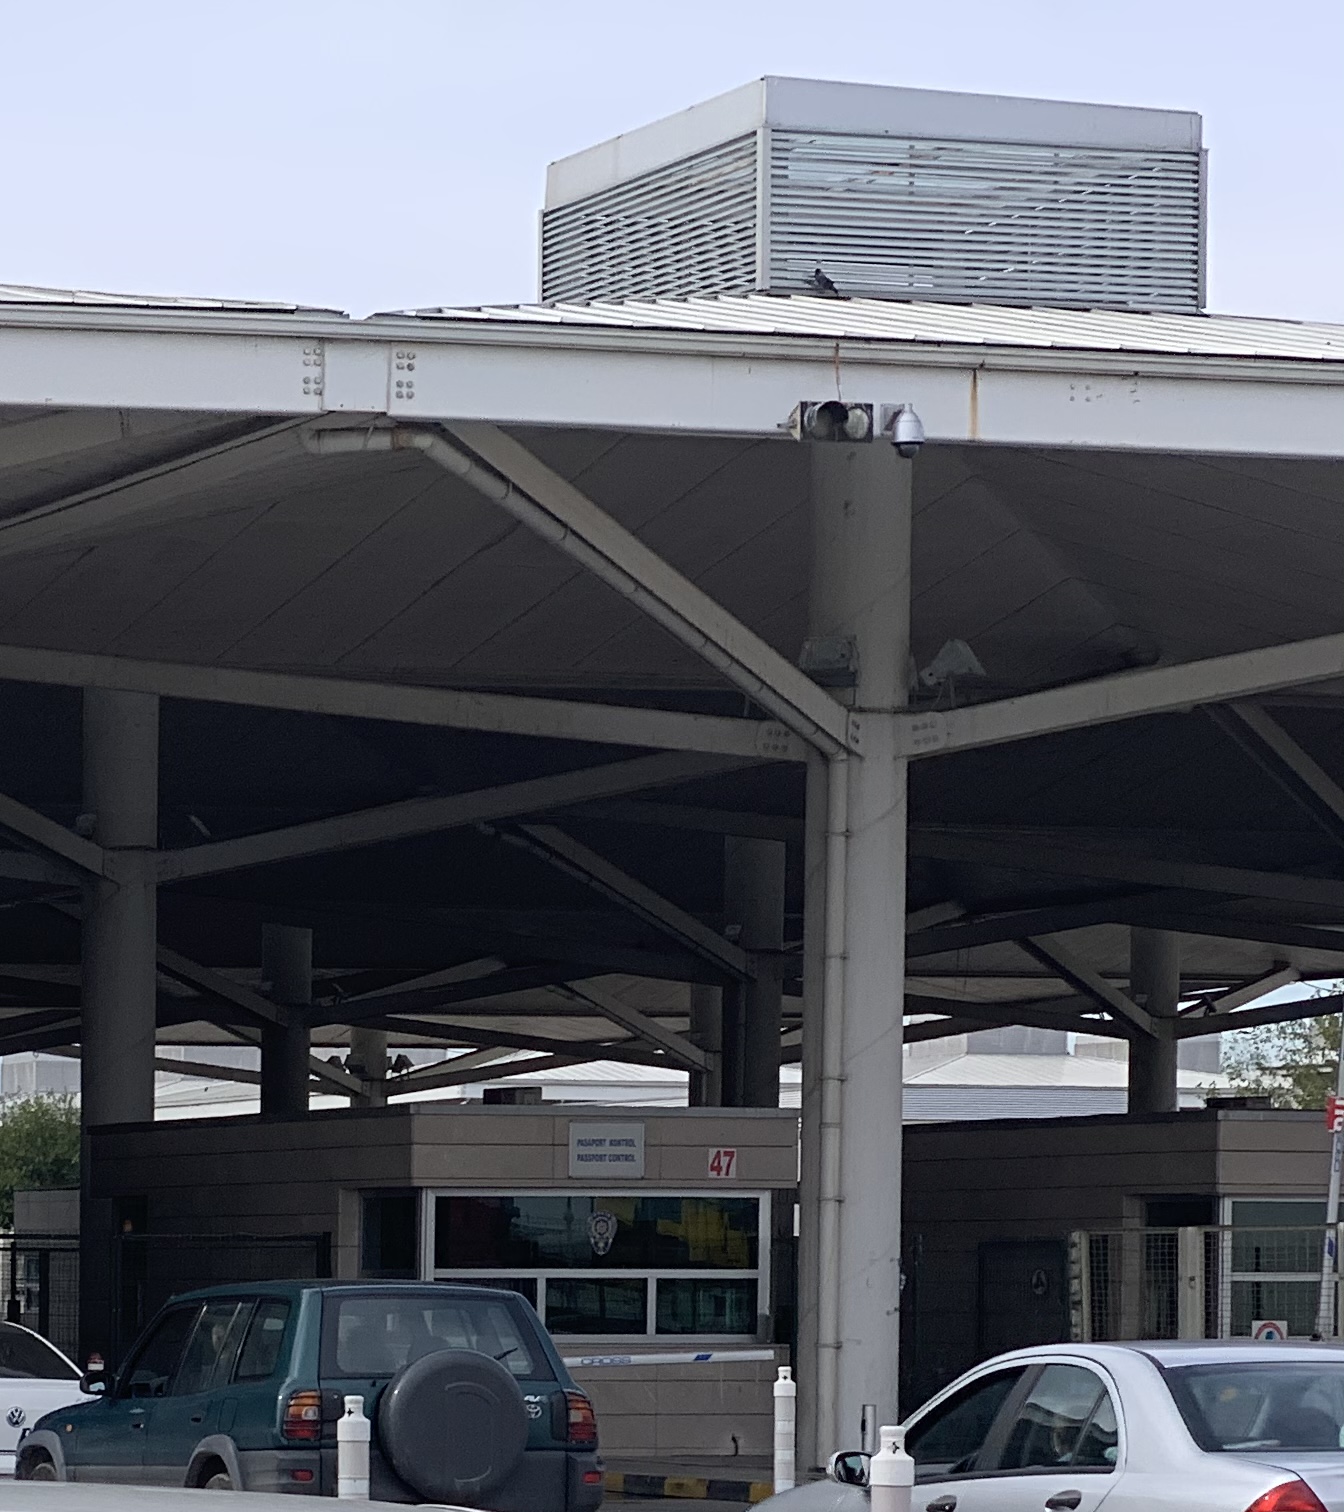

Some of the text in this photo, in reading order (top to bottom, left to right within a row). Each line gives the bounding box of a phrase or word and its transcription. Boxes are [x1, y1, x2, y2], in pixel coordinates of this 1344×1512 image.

[576, 1138, 637, 1148] PASAPORT KONTROL
[576, 1153, 636, 1163] PASSPORT CONTROL
[710, 1150, 735, 1177] 47
[580, 1356, 632, 1367] CROSS
